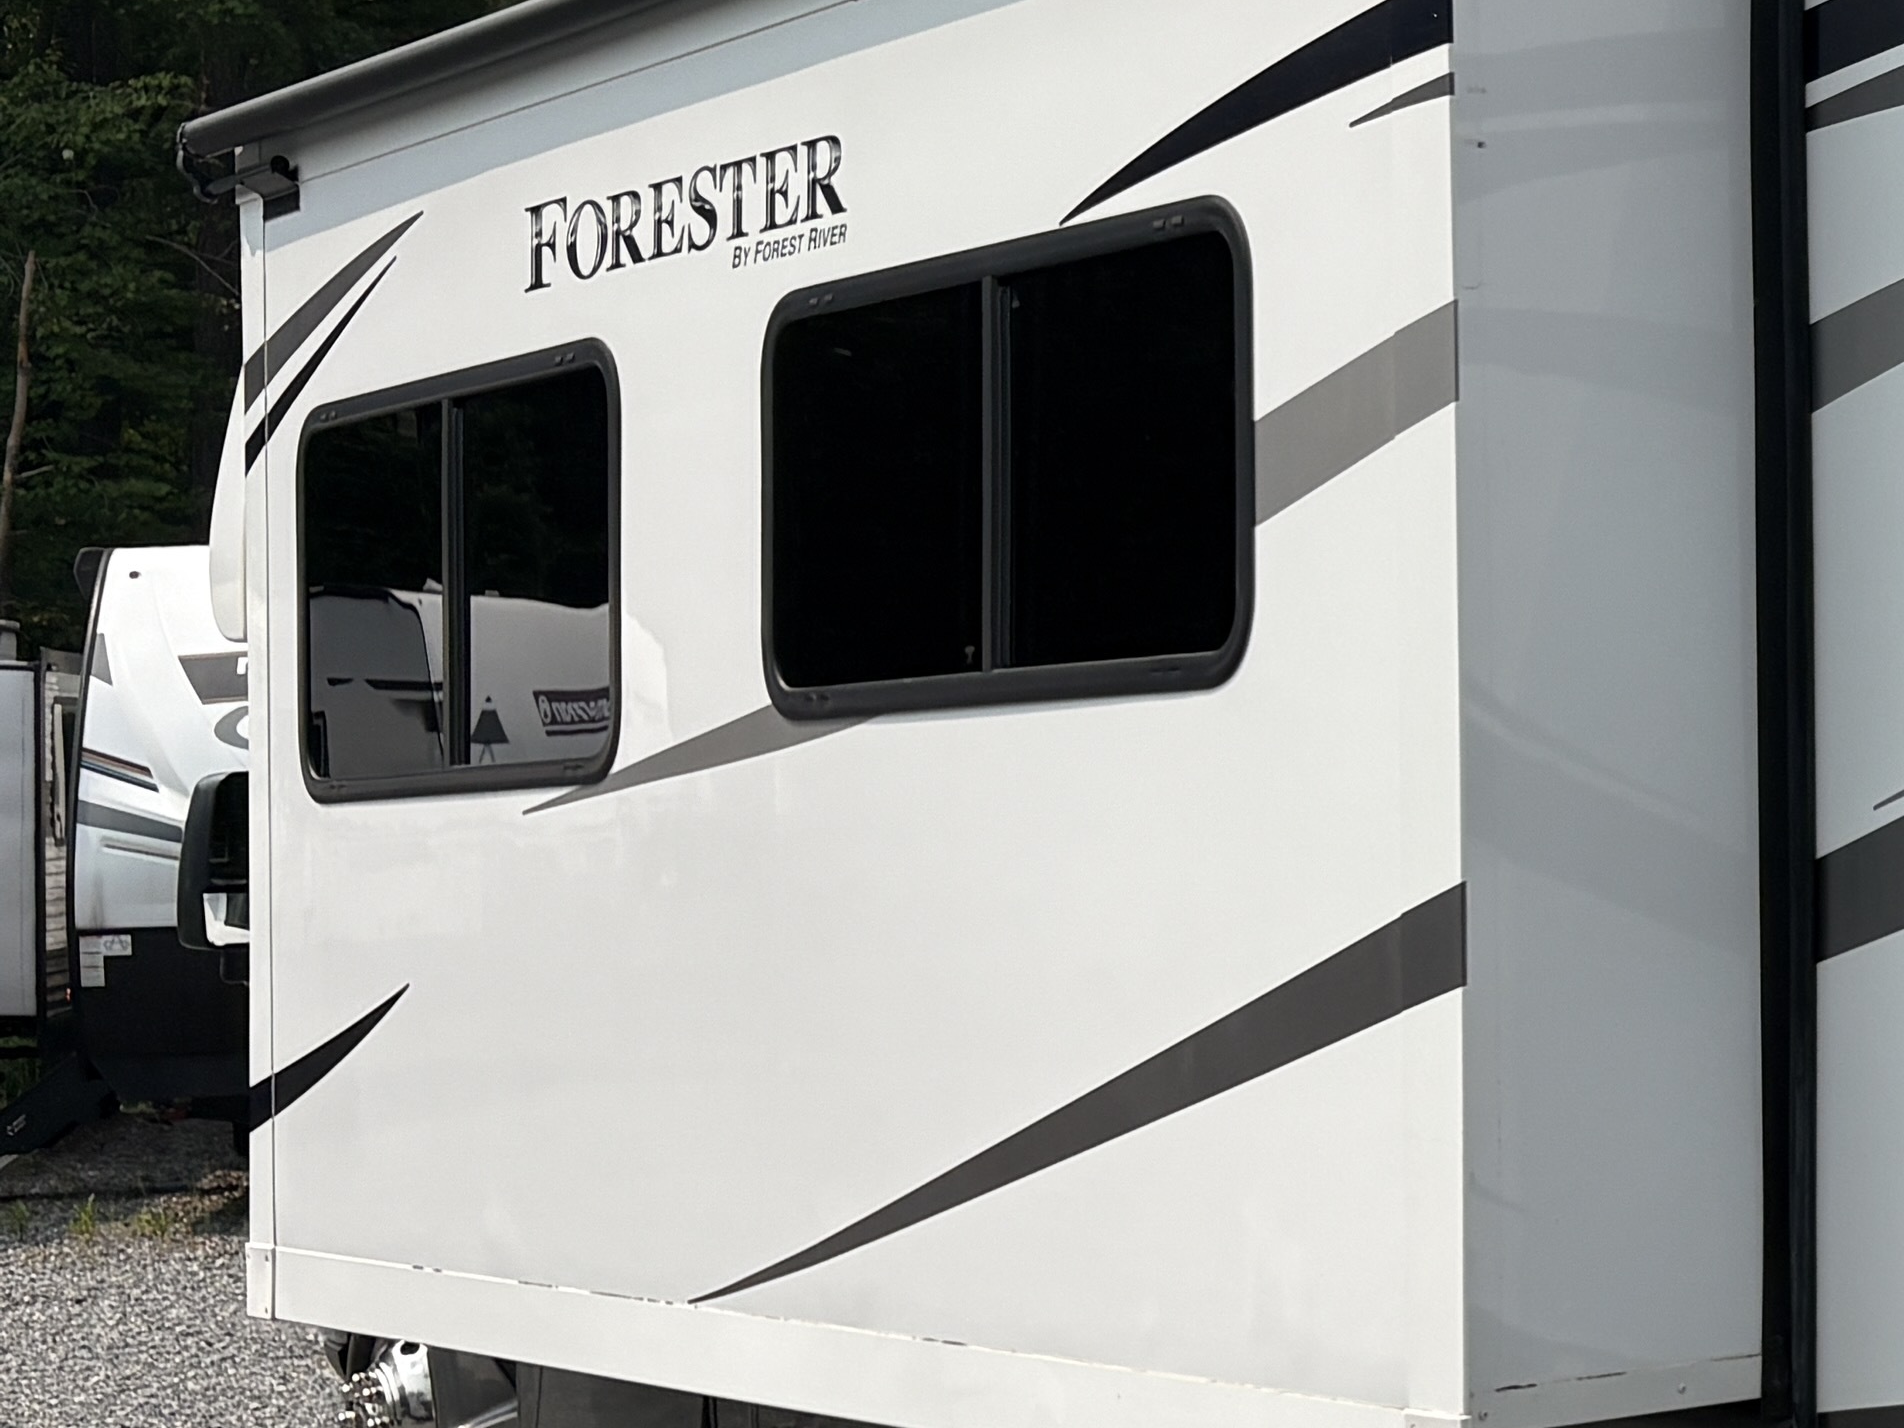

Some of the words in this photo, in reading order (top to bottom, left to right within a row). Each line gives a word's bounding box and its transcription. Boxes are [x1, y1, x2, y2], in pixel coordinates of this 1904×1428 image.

[524, 133, 847, 293] FORESTER
[732, 244, 751, 270] BY
[753, 233, 804, 266] FOREST
[807, 222, 848, 252] RIVER
